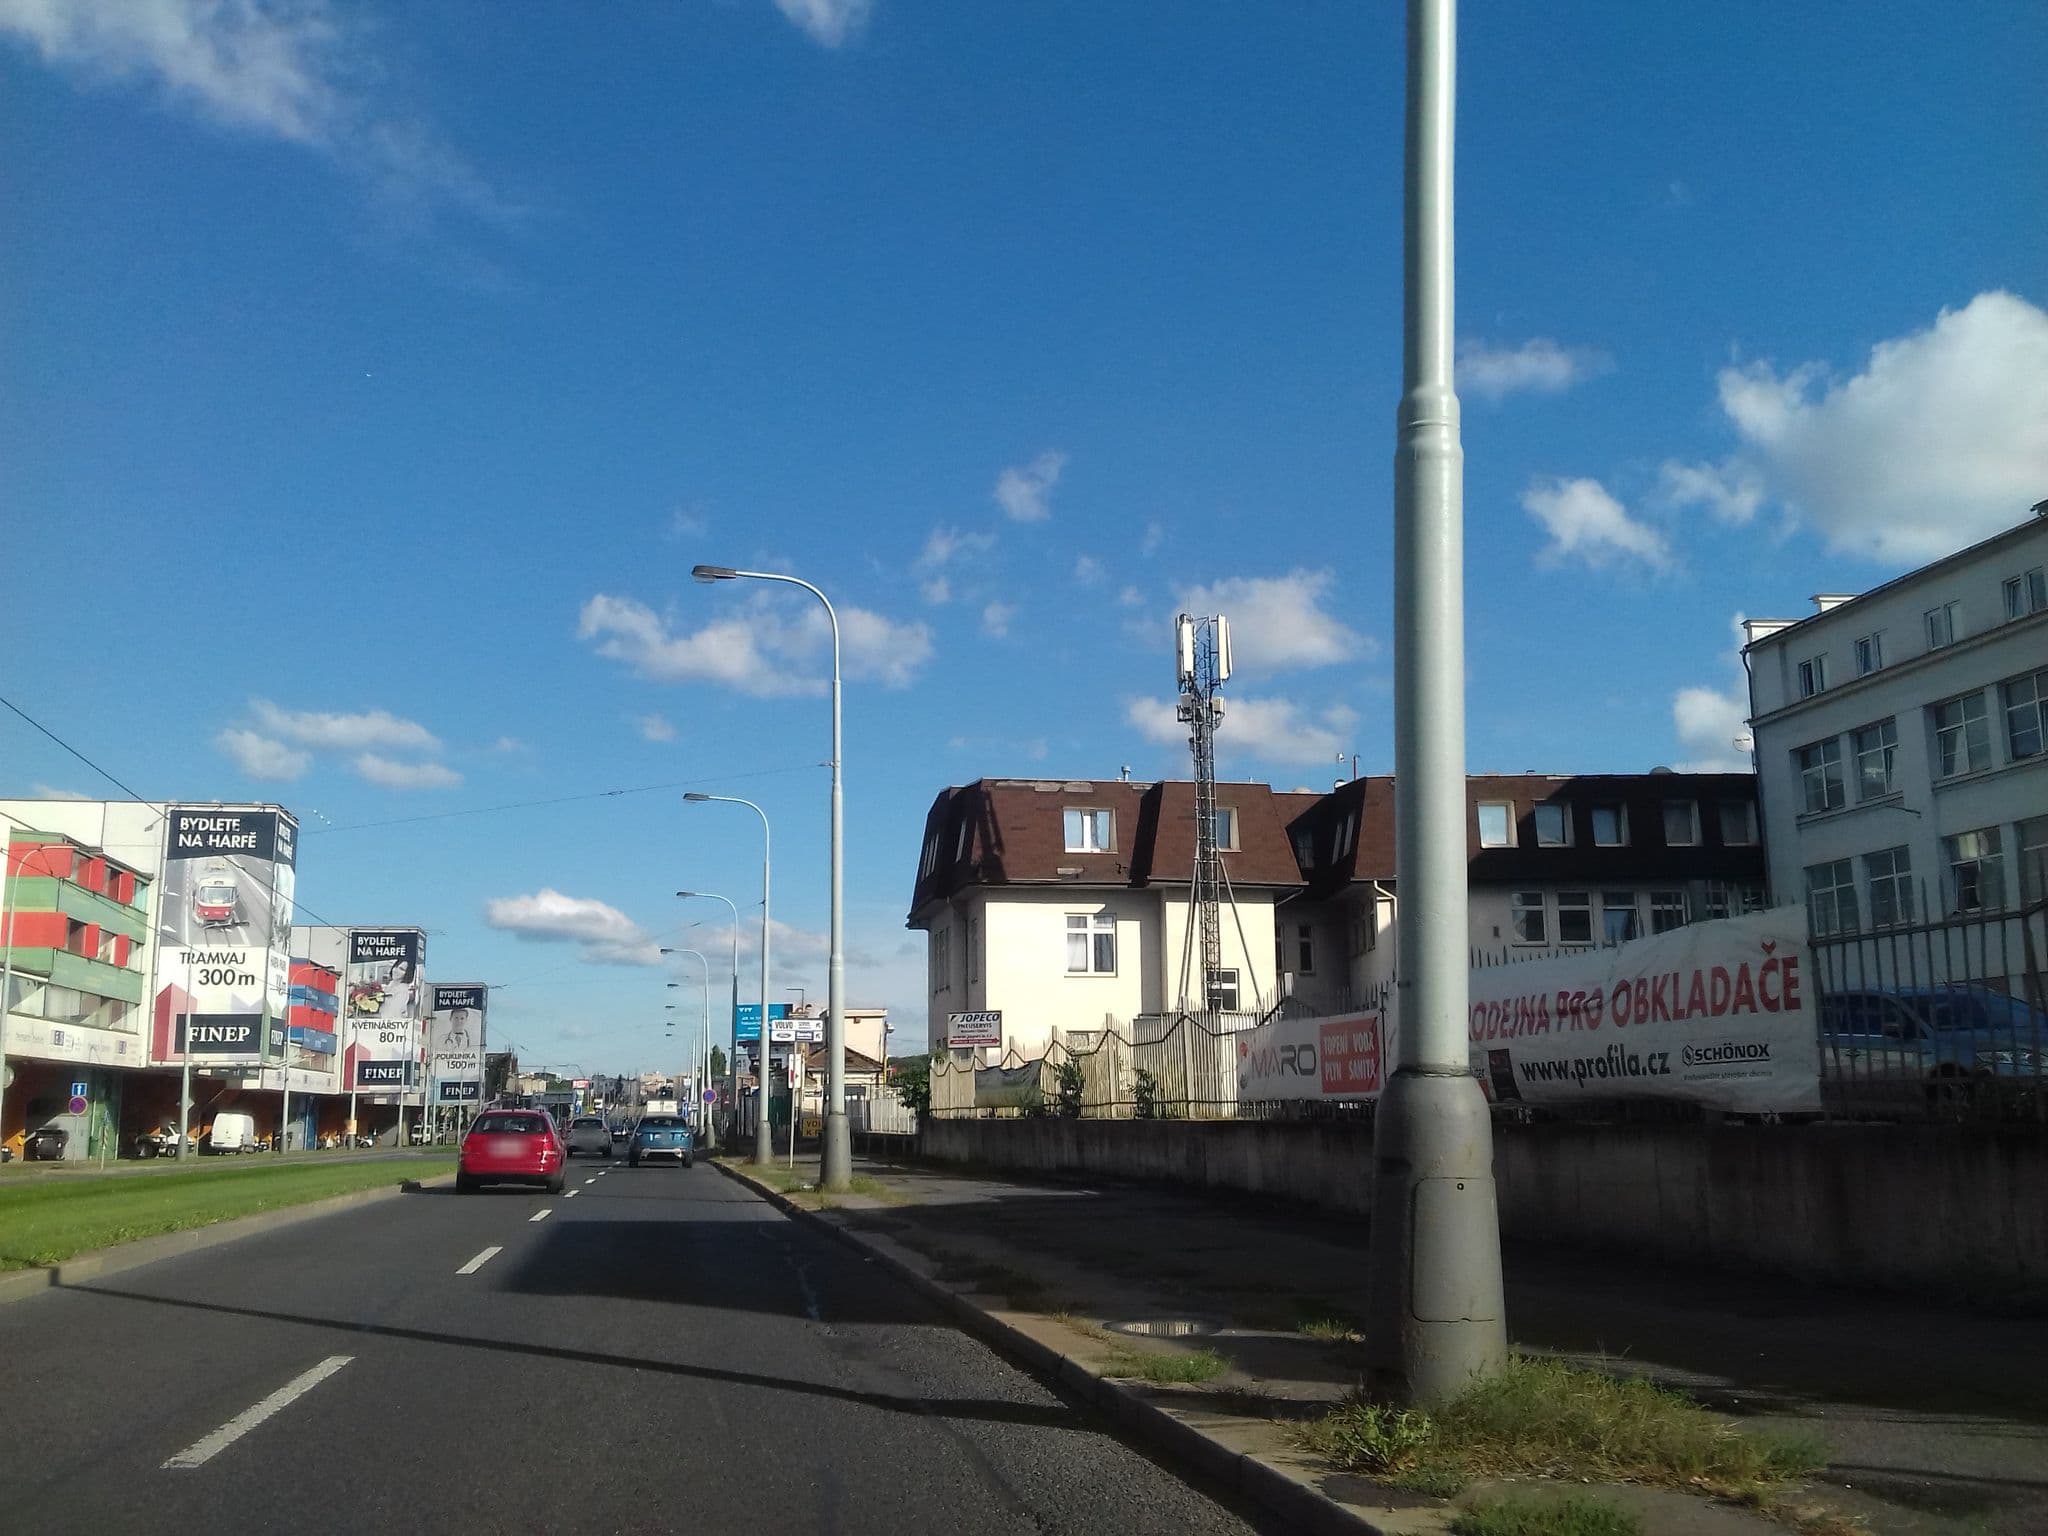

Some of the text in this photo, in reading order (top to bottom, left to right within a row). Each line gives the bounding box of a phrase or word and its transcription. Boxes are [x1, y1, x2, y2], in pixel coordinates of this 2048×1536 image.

[180, 817, 241, 831] BYDLETE
[178, 832, 257, 848] NA HARFĚ
[357, 936, 396, 946] BYDLETE
[357, 947, 373, 956] NA
[375, 945, 406, 956] HARFĚ
[179, 952, 246, 965] TRAMVAJ
[198, 968, 255, 985] 300 m
[439, 990, 467, 998] BYDLETE
[1469, 939, 1802, 1042] ODEJNA PRO OBKLADAČE
[438, 998, 454, 1006] NA
[960, 1013, 1000, 1022] JOPECO
[351, 1020, 409, 1030] KVĚTINÁŘSTVÍ
[774, 1021, 794, 1029] VOLVO
[188, 1026, 251, 1042] FINEP
[379, 1032, 406, 1043] 80 m
[1324, 1031, 1375, 1055] TOPENÍ VODA
[1694, 1042, 1770, 1062] SCHÖNOX
[447, 1060, 467, 1070] 1500
[1251, 1043, 1316, 1080] MARO
[1520, 1043, 1671, 1088] www.profila.cz
[1325, 1061, 1342, 1081] PLYN
[445, 1087, 475, 1096] FINEP
